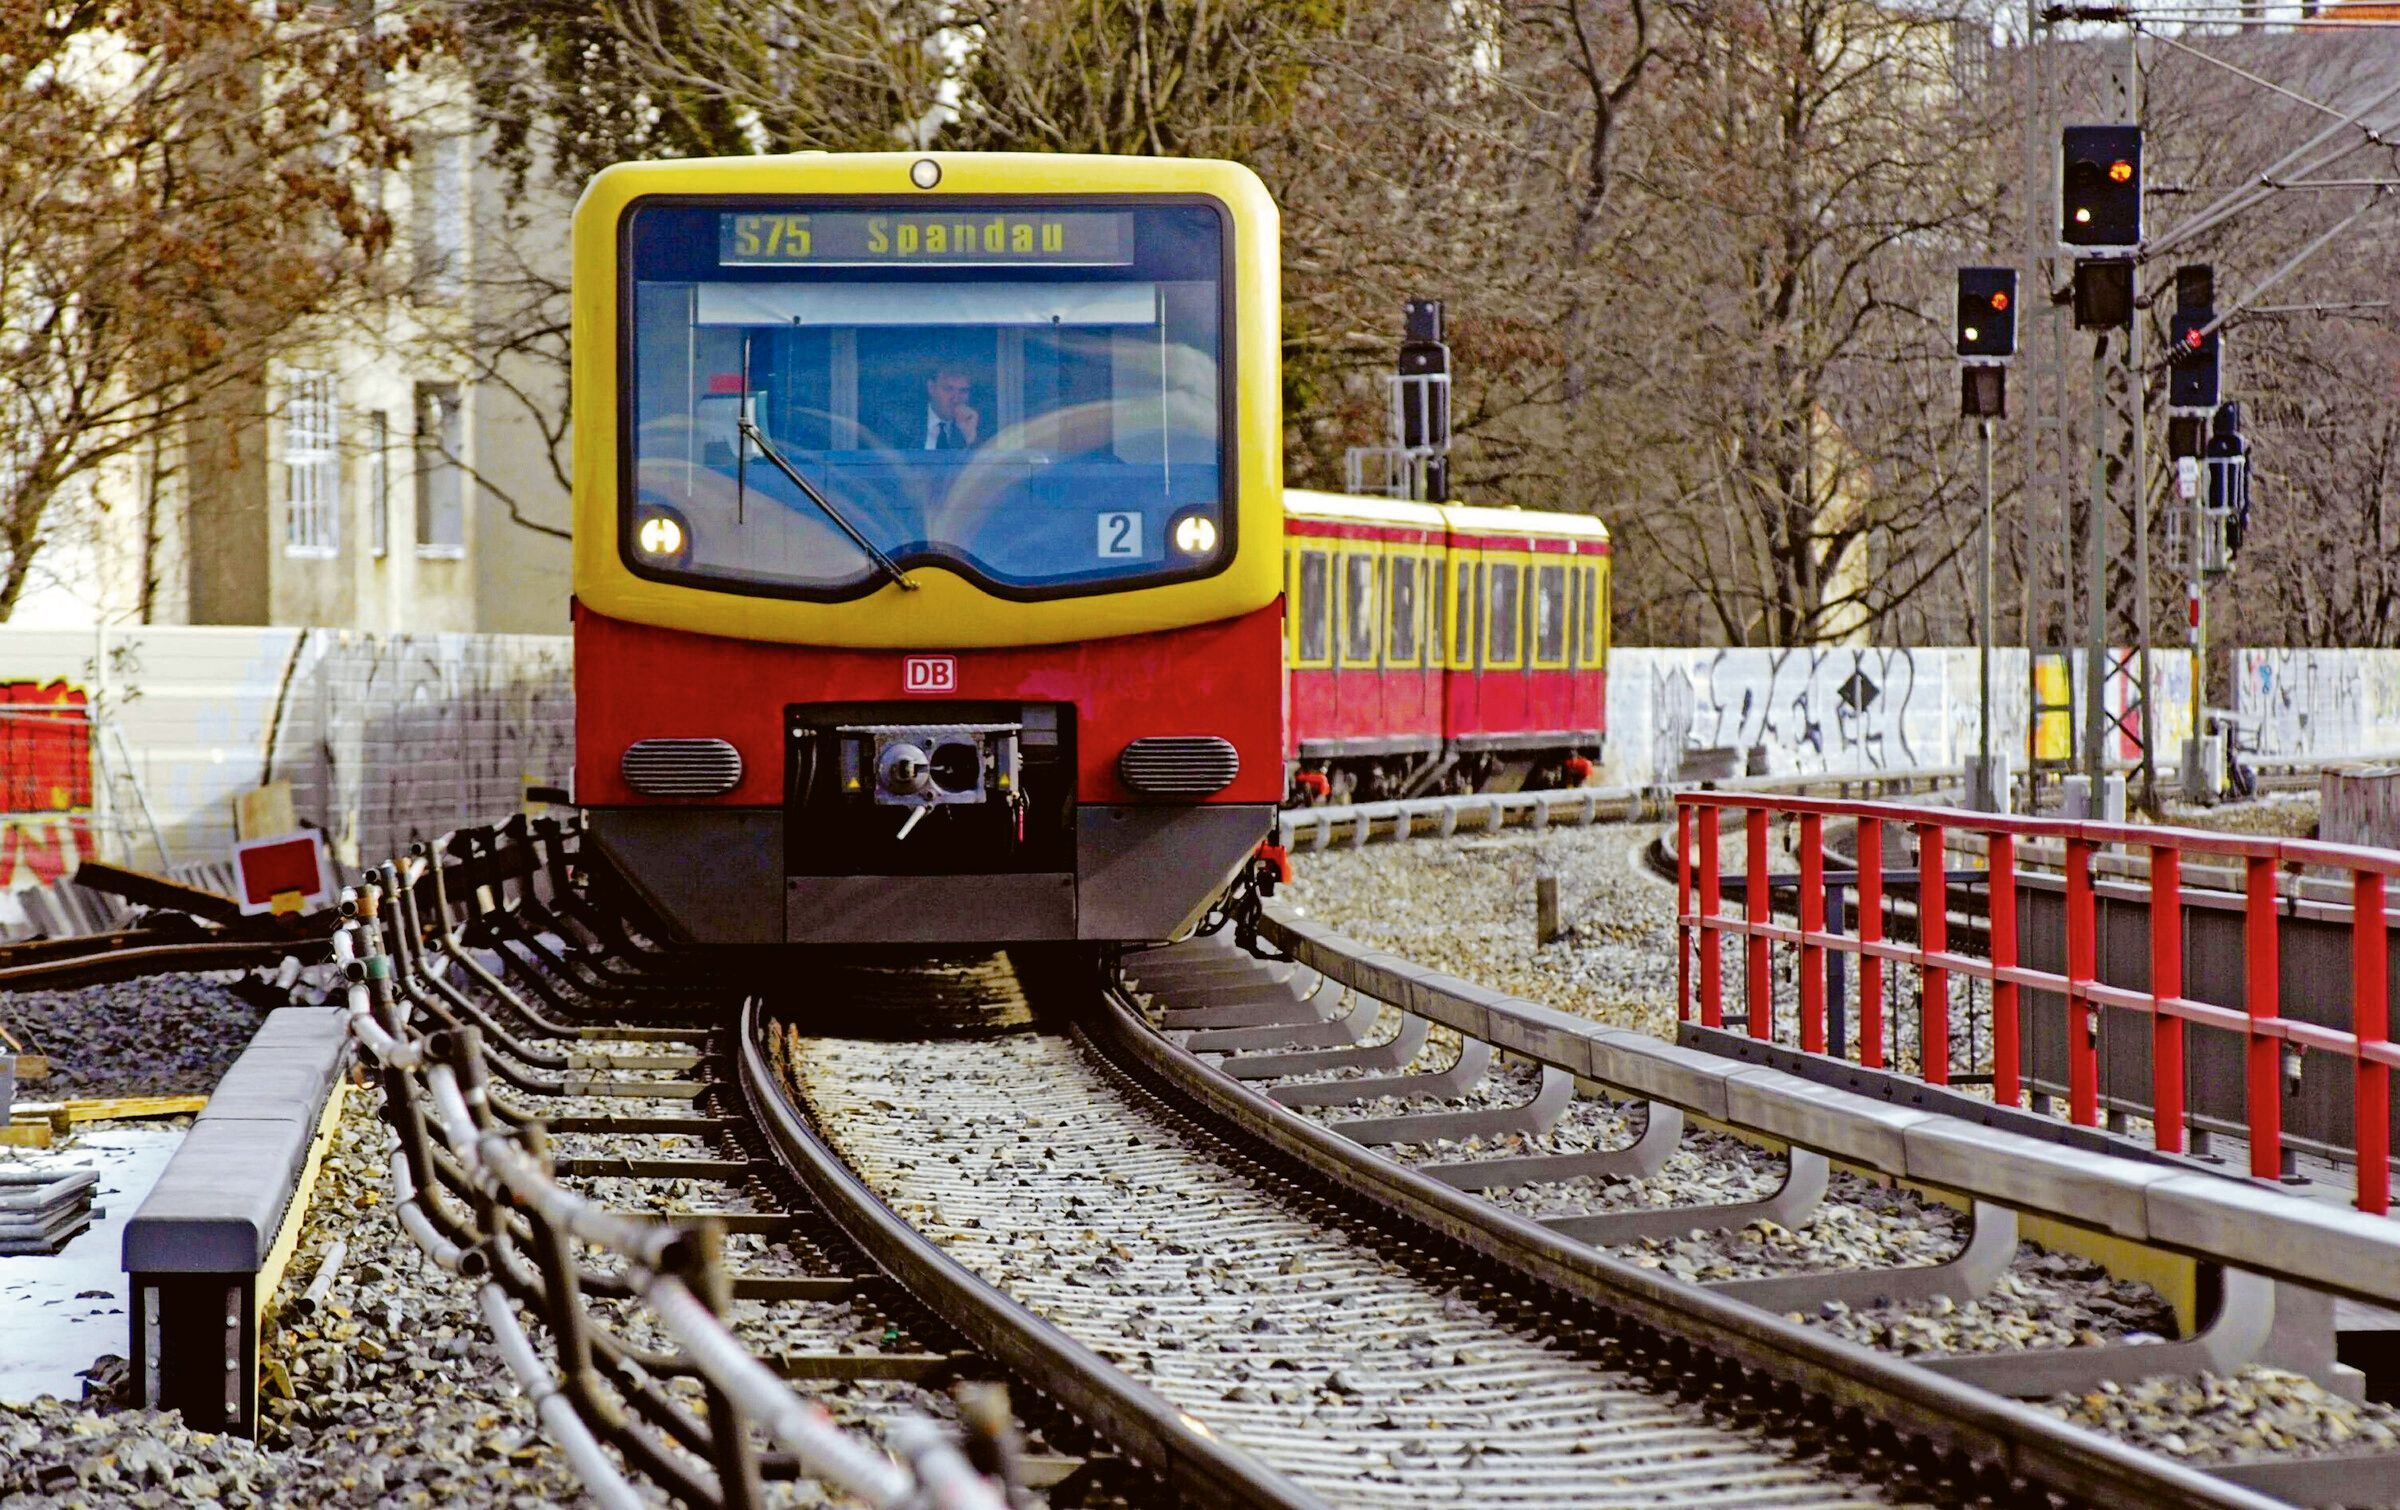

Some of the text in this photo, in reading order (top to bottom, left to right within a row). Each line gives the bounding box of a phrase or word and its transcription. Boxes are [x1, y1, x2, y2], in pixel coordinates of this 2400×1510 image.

[735, 215, 1063, 257] S75 Spandau
[1109, 514, 1131, 553] 2
[911, 662, 949, 685] DB
